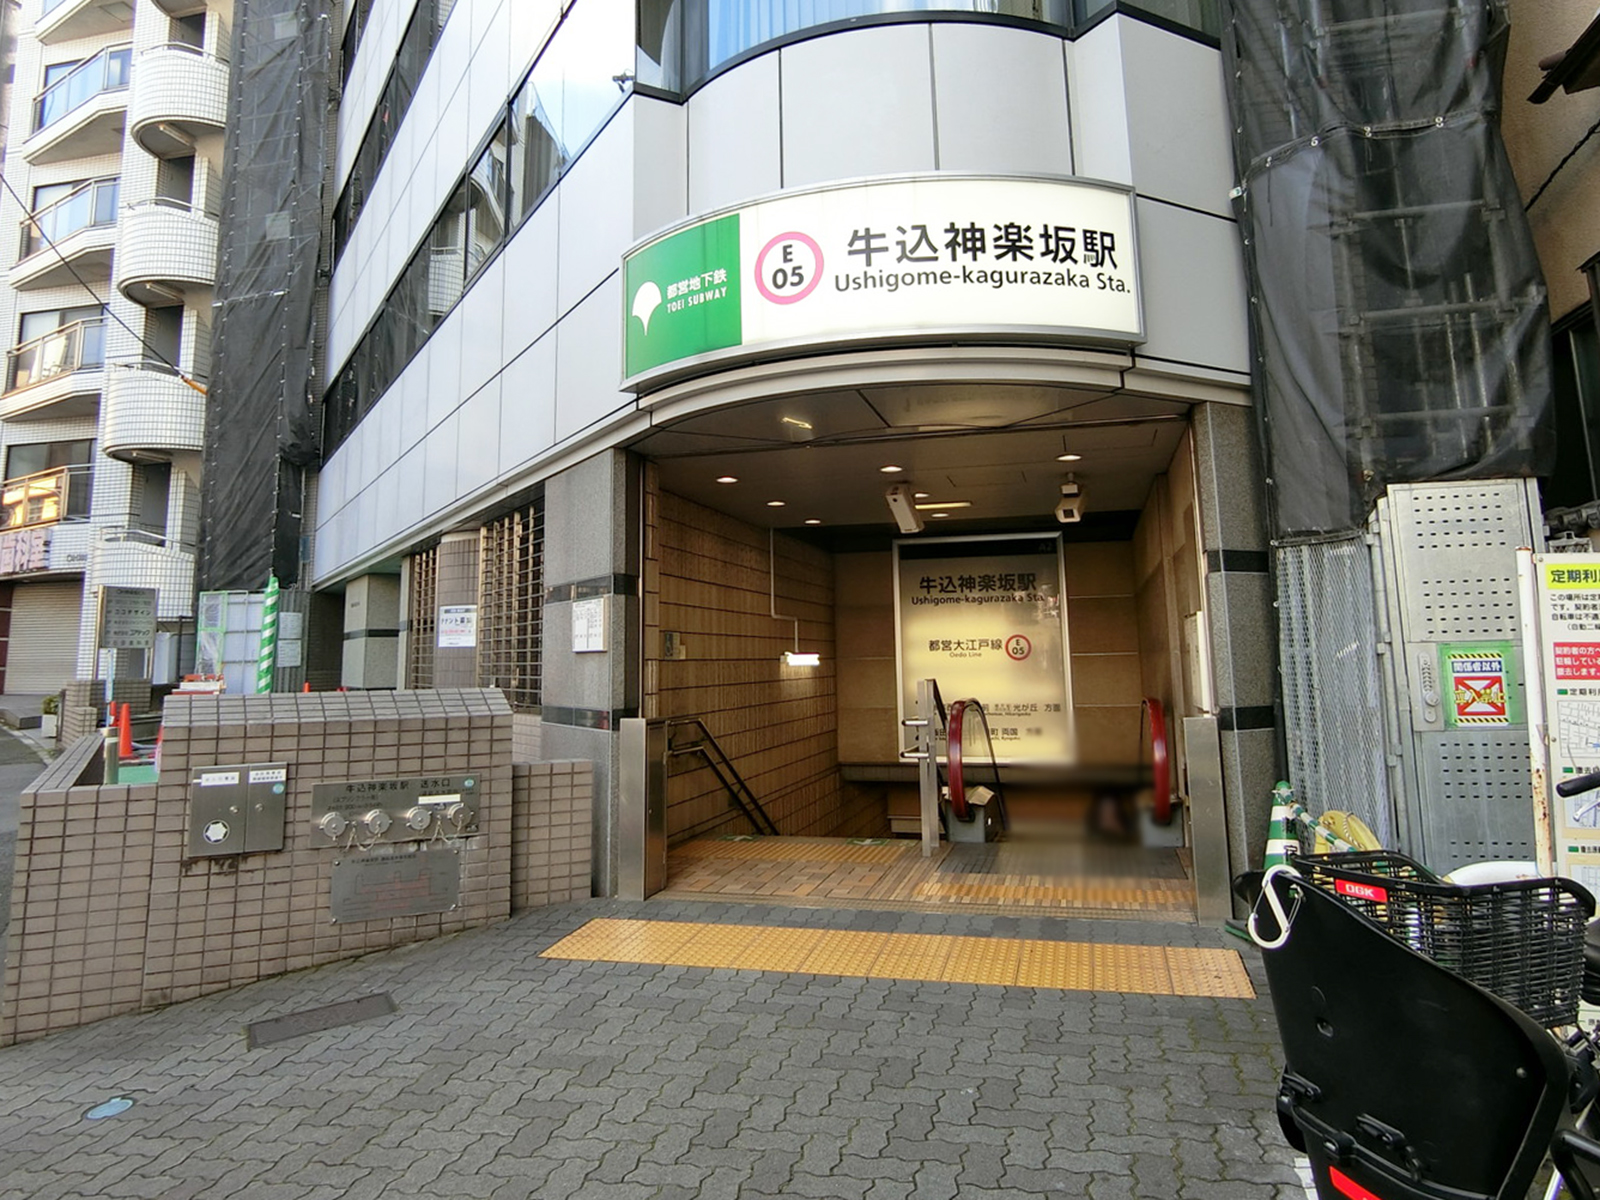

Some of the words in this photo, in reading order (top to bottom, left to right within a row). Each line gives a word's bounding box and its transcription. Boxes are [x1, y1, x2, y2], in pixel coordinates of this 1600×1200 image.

[782, 244, 794, 264] E
[846, 221, 1119, 271] 牛込神楽坂駅
[666, 268, 728, 300] 都営地下鉄
[771, 266, 805, 290] 05
[834, 264, 1090, 293] Ushigome-kagurazaka
[1096, 272, 1132, 294] Sta.
[666, 298, 686, 314] TOEI
[687, 286, 728, 307] SUBWAY
[919, 572, 1037, 595] 牛込神楽坂駅
[1550, 569, 1600, 583] 定期利
[911, 593, 1024, 607] Ushigome-kagurazaka
[928, 638, 1003, 652] 都営大江戸線
[1011, 646, 1025, 656] 05
[1015, 639, 1021, 647] E
[1453, 661, 1501, 673] 関係者以外
[1454, 688, 1506, 705] 立入禁止
[346, 781, 410, 793] 牛込神楽坂駅
[421, 778, 450, 788] 送水口
[1345, 884, 1375, 897] OGK
